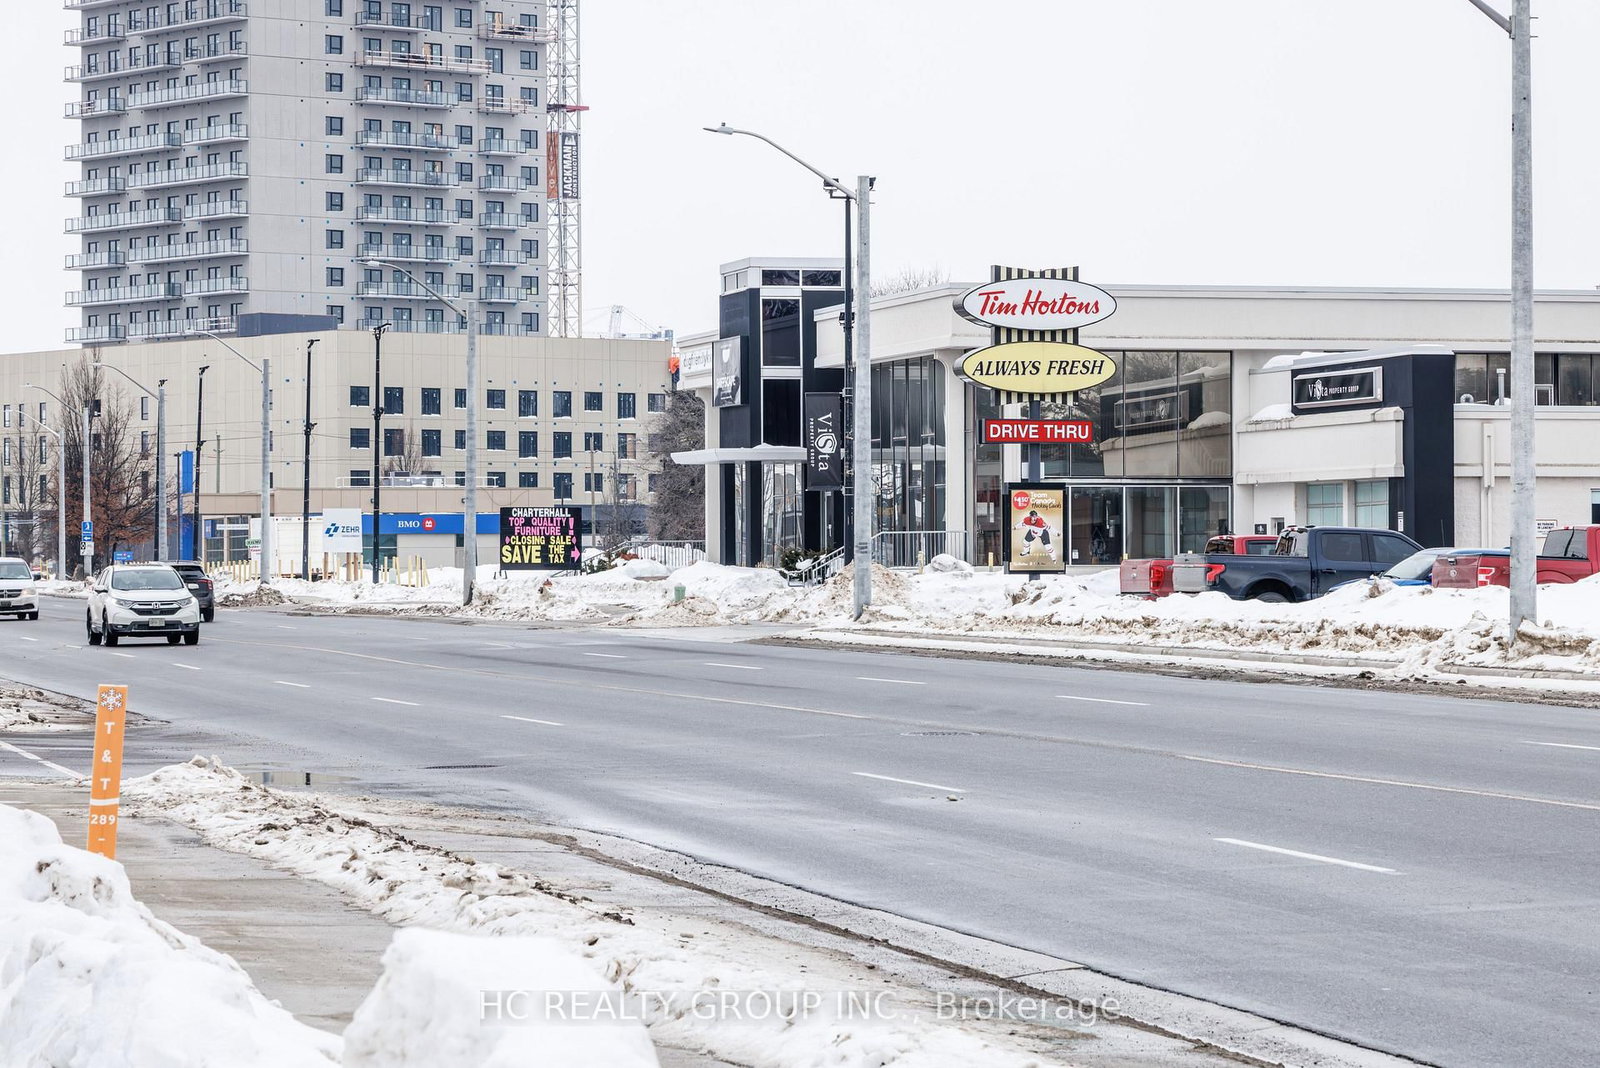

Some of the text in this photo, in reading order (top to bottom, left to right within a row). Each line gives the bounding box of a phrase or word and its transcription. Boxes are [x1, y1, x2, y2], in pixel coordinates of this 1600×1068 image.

[563, 146, 572, 196] JACKMAN
[978, 289, 1100, 316] Tim Hortons
[972, 359, 1105, 376] ALWAYS FRESH
[1329, 386, 1348, 394] PROPERTY
[989, 424, 1089, 439] DRIVE THRU
[512, 508, 571, 517] CHARTERHALL
[508, 518, 525, 526] TOP
[531, 518, 566, 526] QUALITY
[341, 523, 360, 533] ZEHR
[514, 527, 561, 535] FURNITURE
[510, 536, 572, 544] CLOSING SALE
[548, 545, 564, 554] THE
[501, 545, 542, 564] SAVE
[548, 554, 564, 563] TAX
[90, 814, 116, 825] 289
